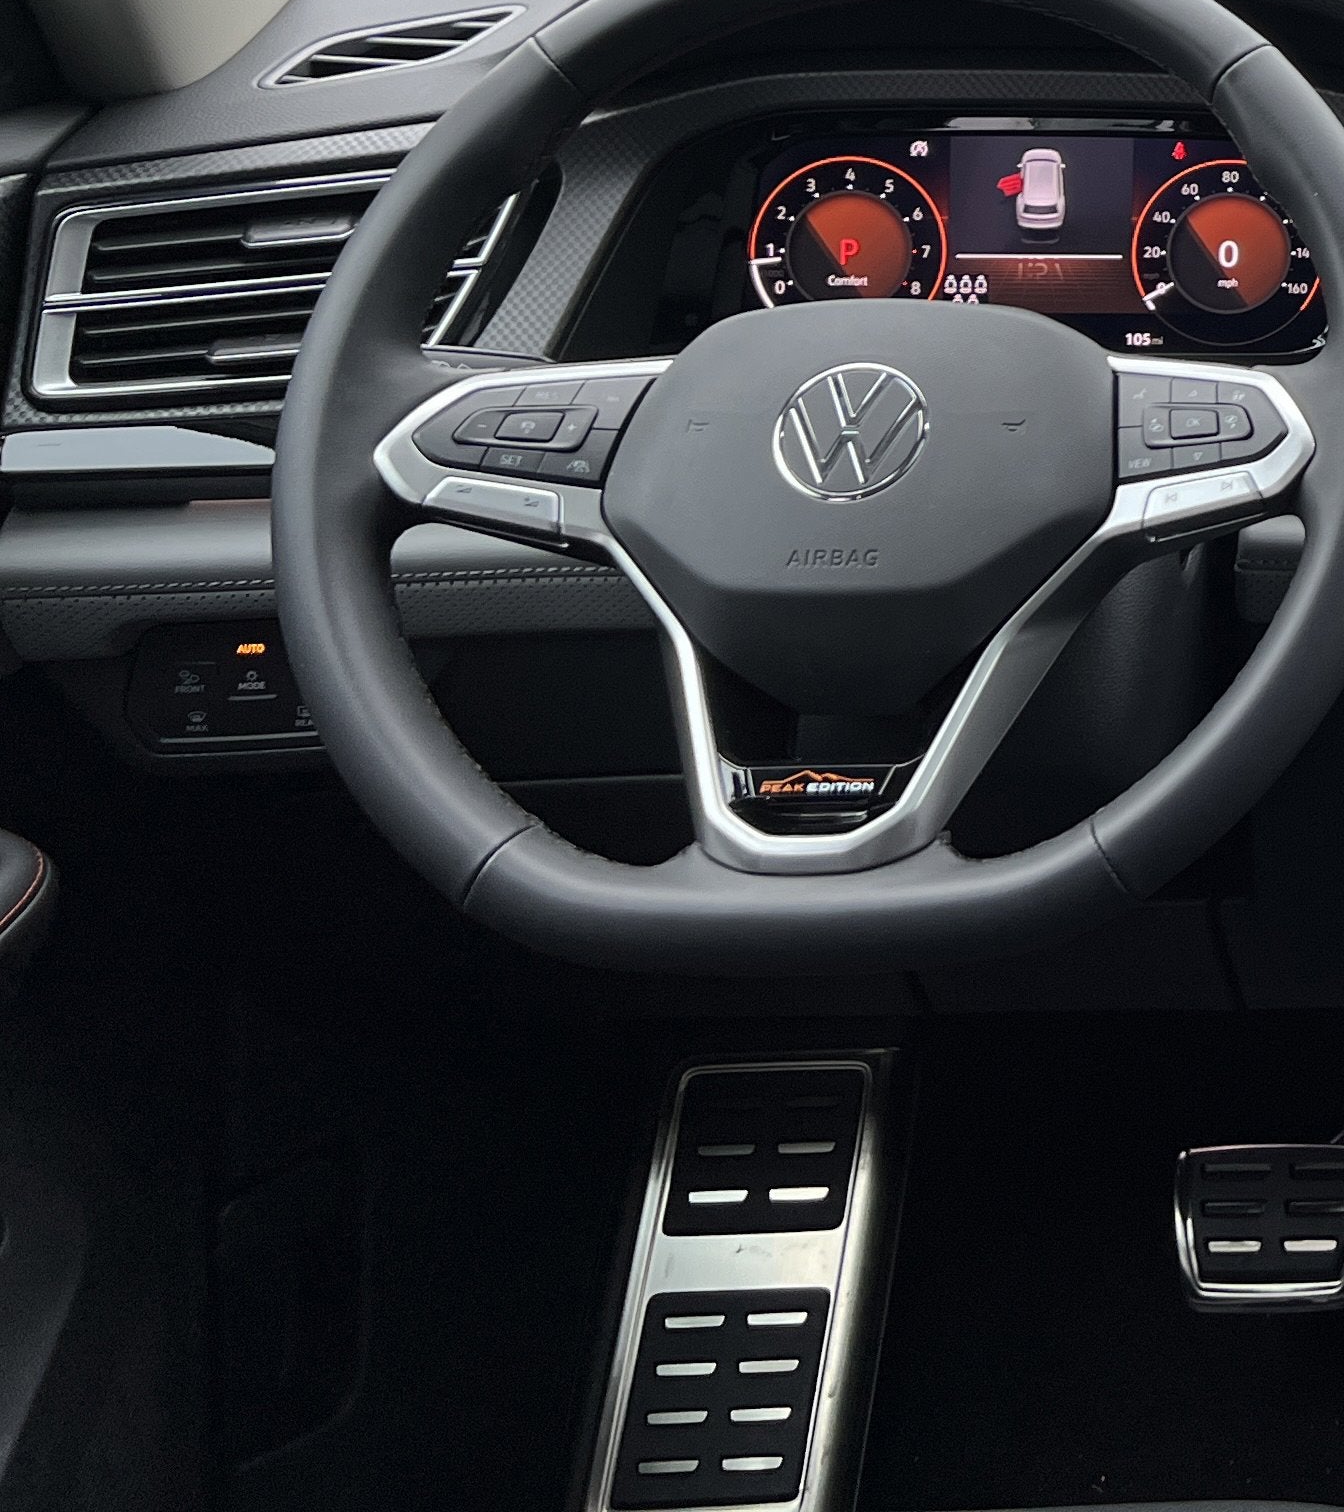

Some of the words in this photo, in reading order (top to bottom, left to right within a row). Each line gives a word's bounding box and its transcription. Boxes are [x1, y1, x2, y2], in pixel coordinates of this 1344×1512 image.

[844, 167, 856, 182] 4
[1221, 171, 1240, 184] 80
[805, 178, 817, 193] 3
[884, 178, 895, 193] 5
[1180, 183, 1199, 196] 60
[776, 205, 788, 220] 2
[911, 206, 924, 221] 6
[1152, 211, 1171, 224] 40
[765, 243, 775, 257] 1
[838, 238, 860, 266] P
[921, 244, 932, 259] 7
[1143, 245, 1161, 259] 20
[1217, 239, 1239, 268] 0
[1295, 247, 1311, 259] 14
[773, 279, 786, 295] 0
[827, 274, 868, 287] Comfort
[1216, 278, 1239, 289] mph
[910, 281, 922, 296] 8
[1286, 282, 1308, 295] 160
[1124, 332, 1152, 346] 105
[500, 453, 524, 467] SET
[1127, 458, 1152, 470] VIEW
[785, 548, 880, 567] AIRBAG
[235, 642, 267, 655] AUTO
[237, 681, 267, 691] MODE
[759, 783, 805, 794] PEAK
[806, 781, 875, 794] EDITION
